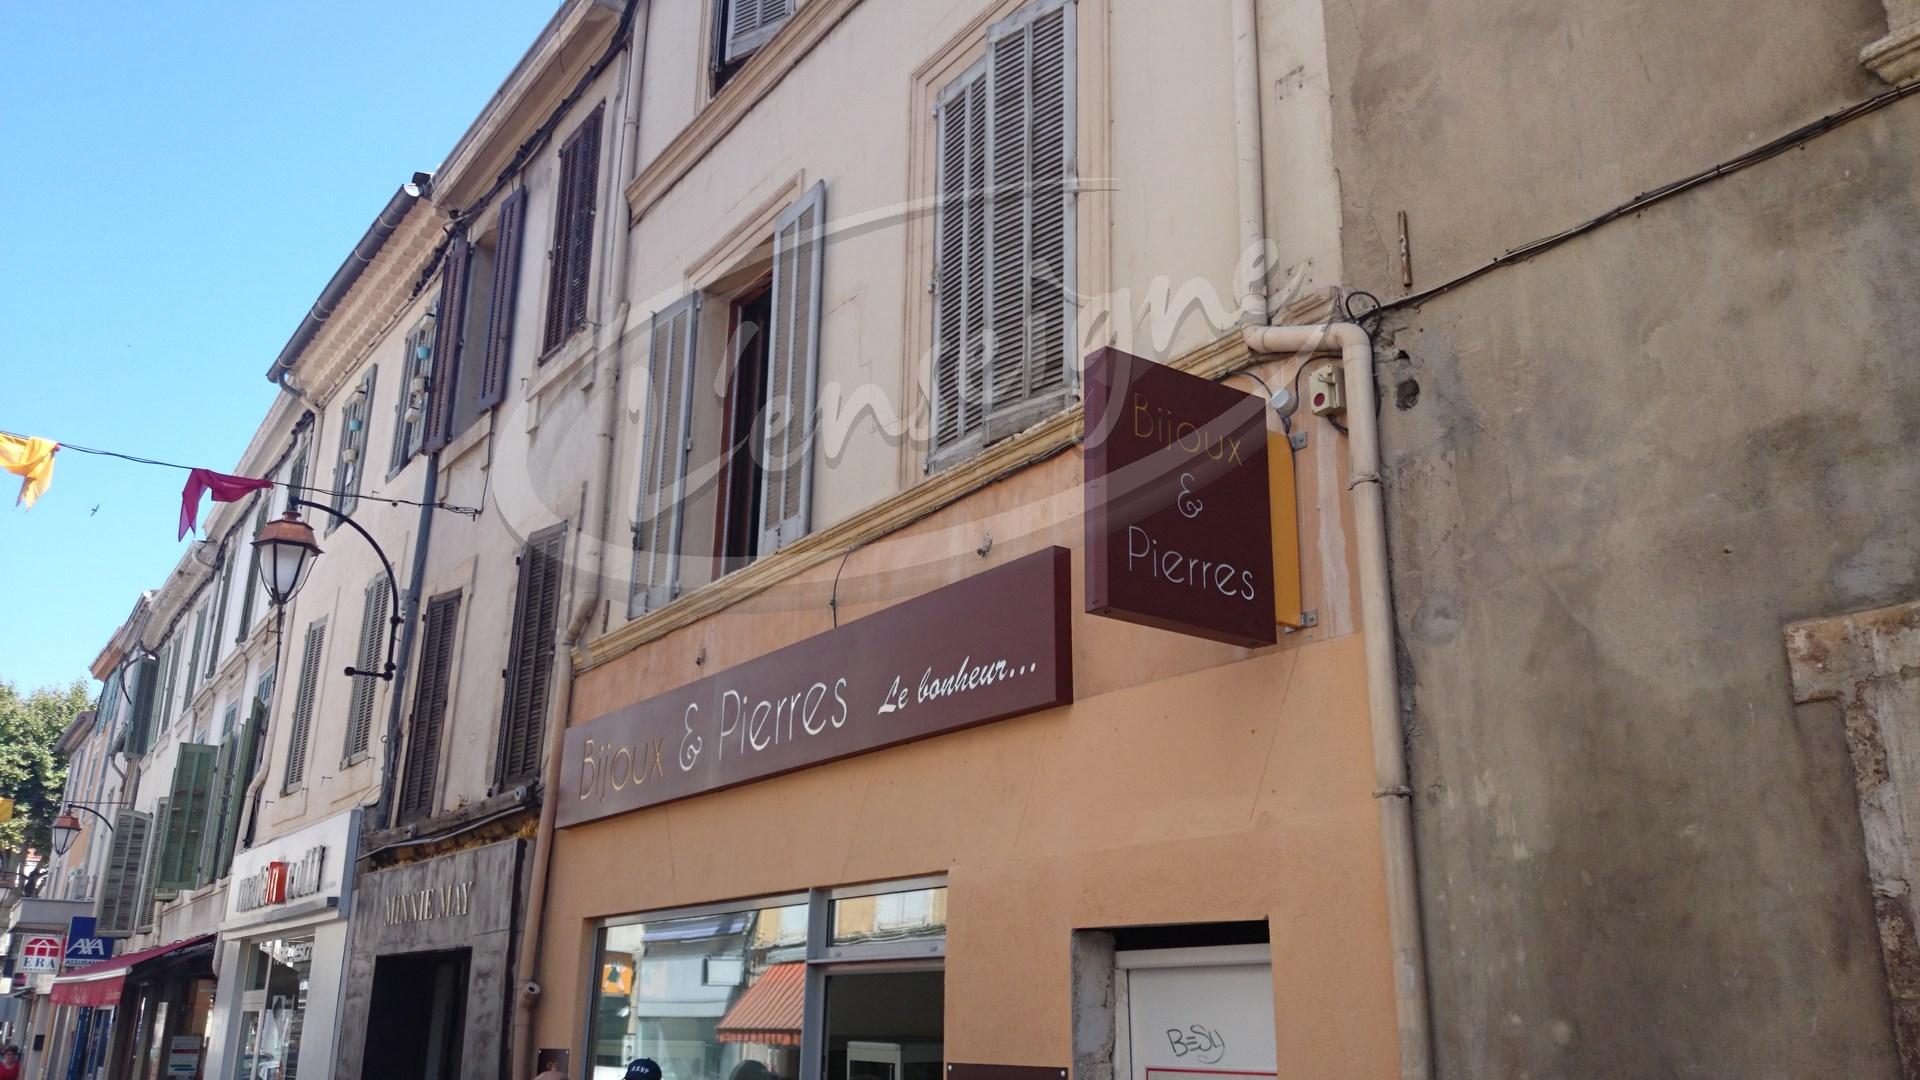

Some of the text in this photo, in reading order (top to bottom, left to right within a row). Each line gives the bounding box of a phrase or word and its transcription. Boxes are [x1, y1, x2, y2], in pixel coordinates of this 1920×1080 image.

[1134, 392, 1242, 467] Bijoux
[1177, 472, 1203, 518] &
[1128, 525, 1255, 601] Pierres
[580, 736, 664, 803] Bijoux
[679, 702, 703, 772] &
[719, 677, 848, 761] Pierres
[878, 674, 909, 716] Le
[23, 957, 56, 969] ERA
[66, 938, 105, 956] AXA
